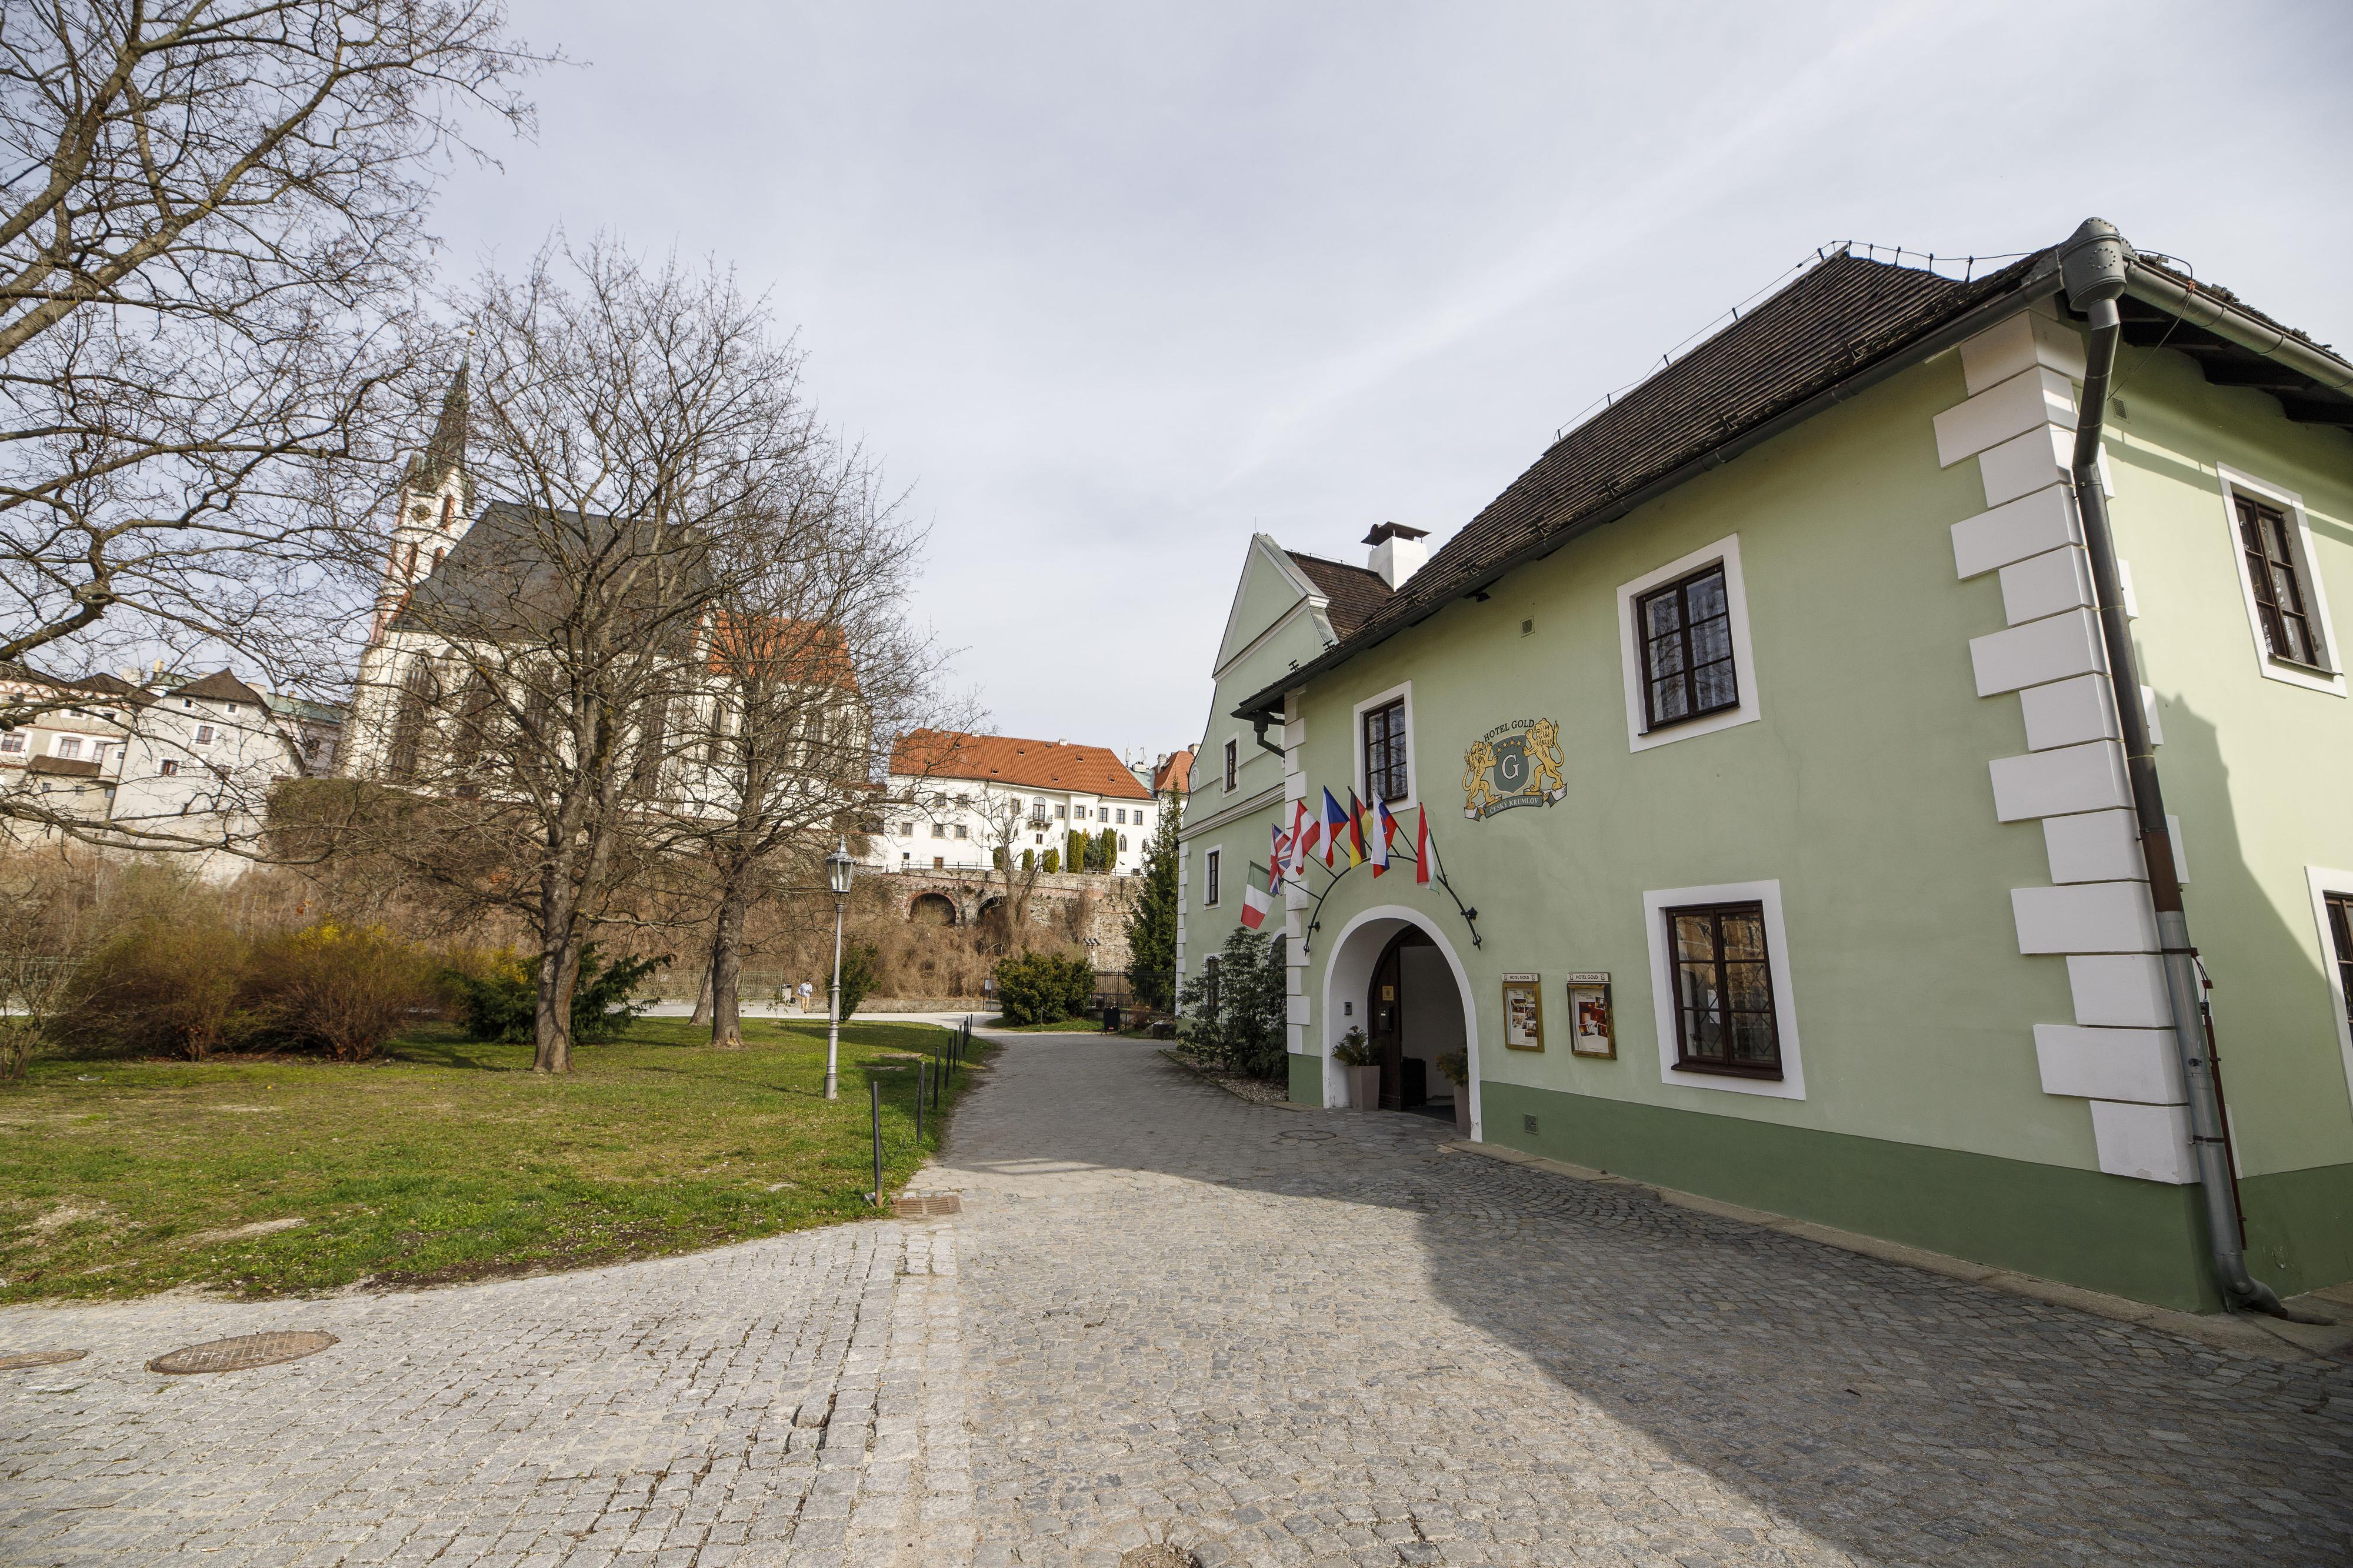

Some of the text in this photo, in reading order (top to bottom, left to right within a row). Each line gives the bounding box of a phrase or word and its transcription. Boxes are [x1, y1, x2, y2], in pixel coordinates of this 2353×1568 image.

[1484, 719, 1535, 742] HOTEL GOLD
[1502, 753, 1520, 780] G
